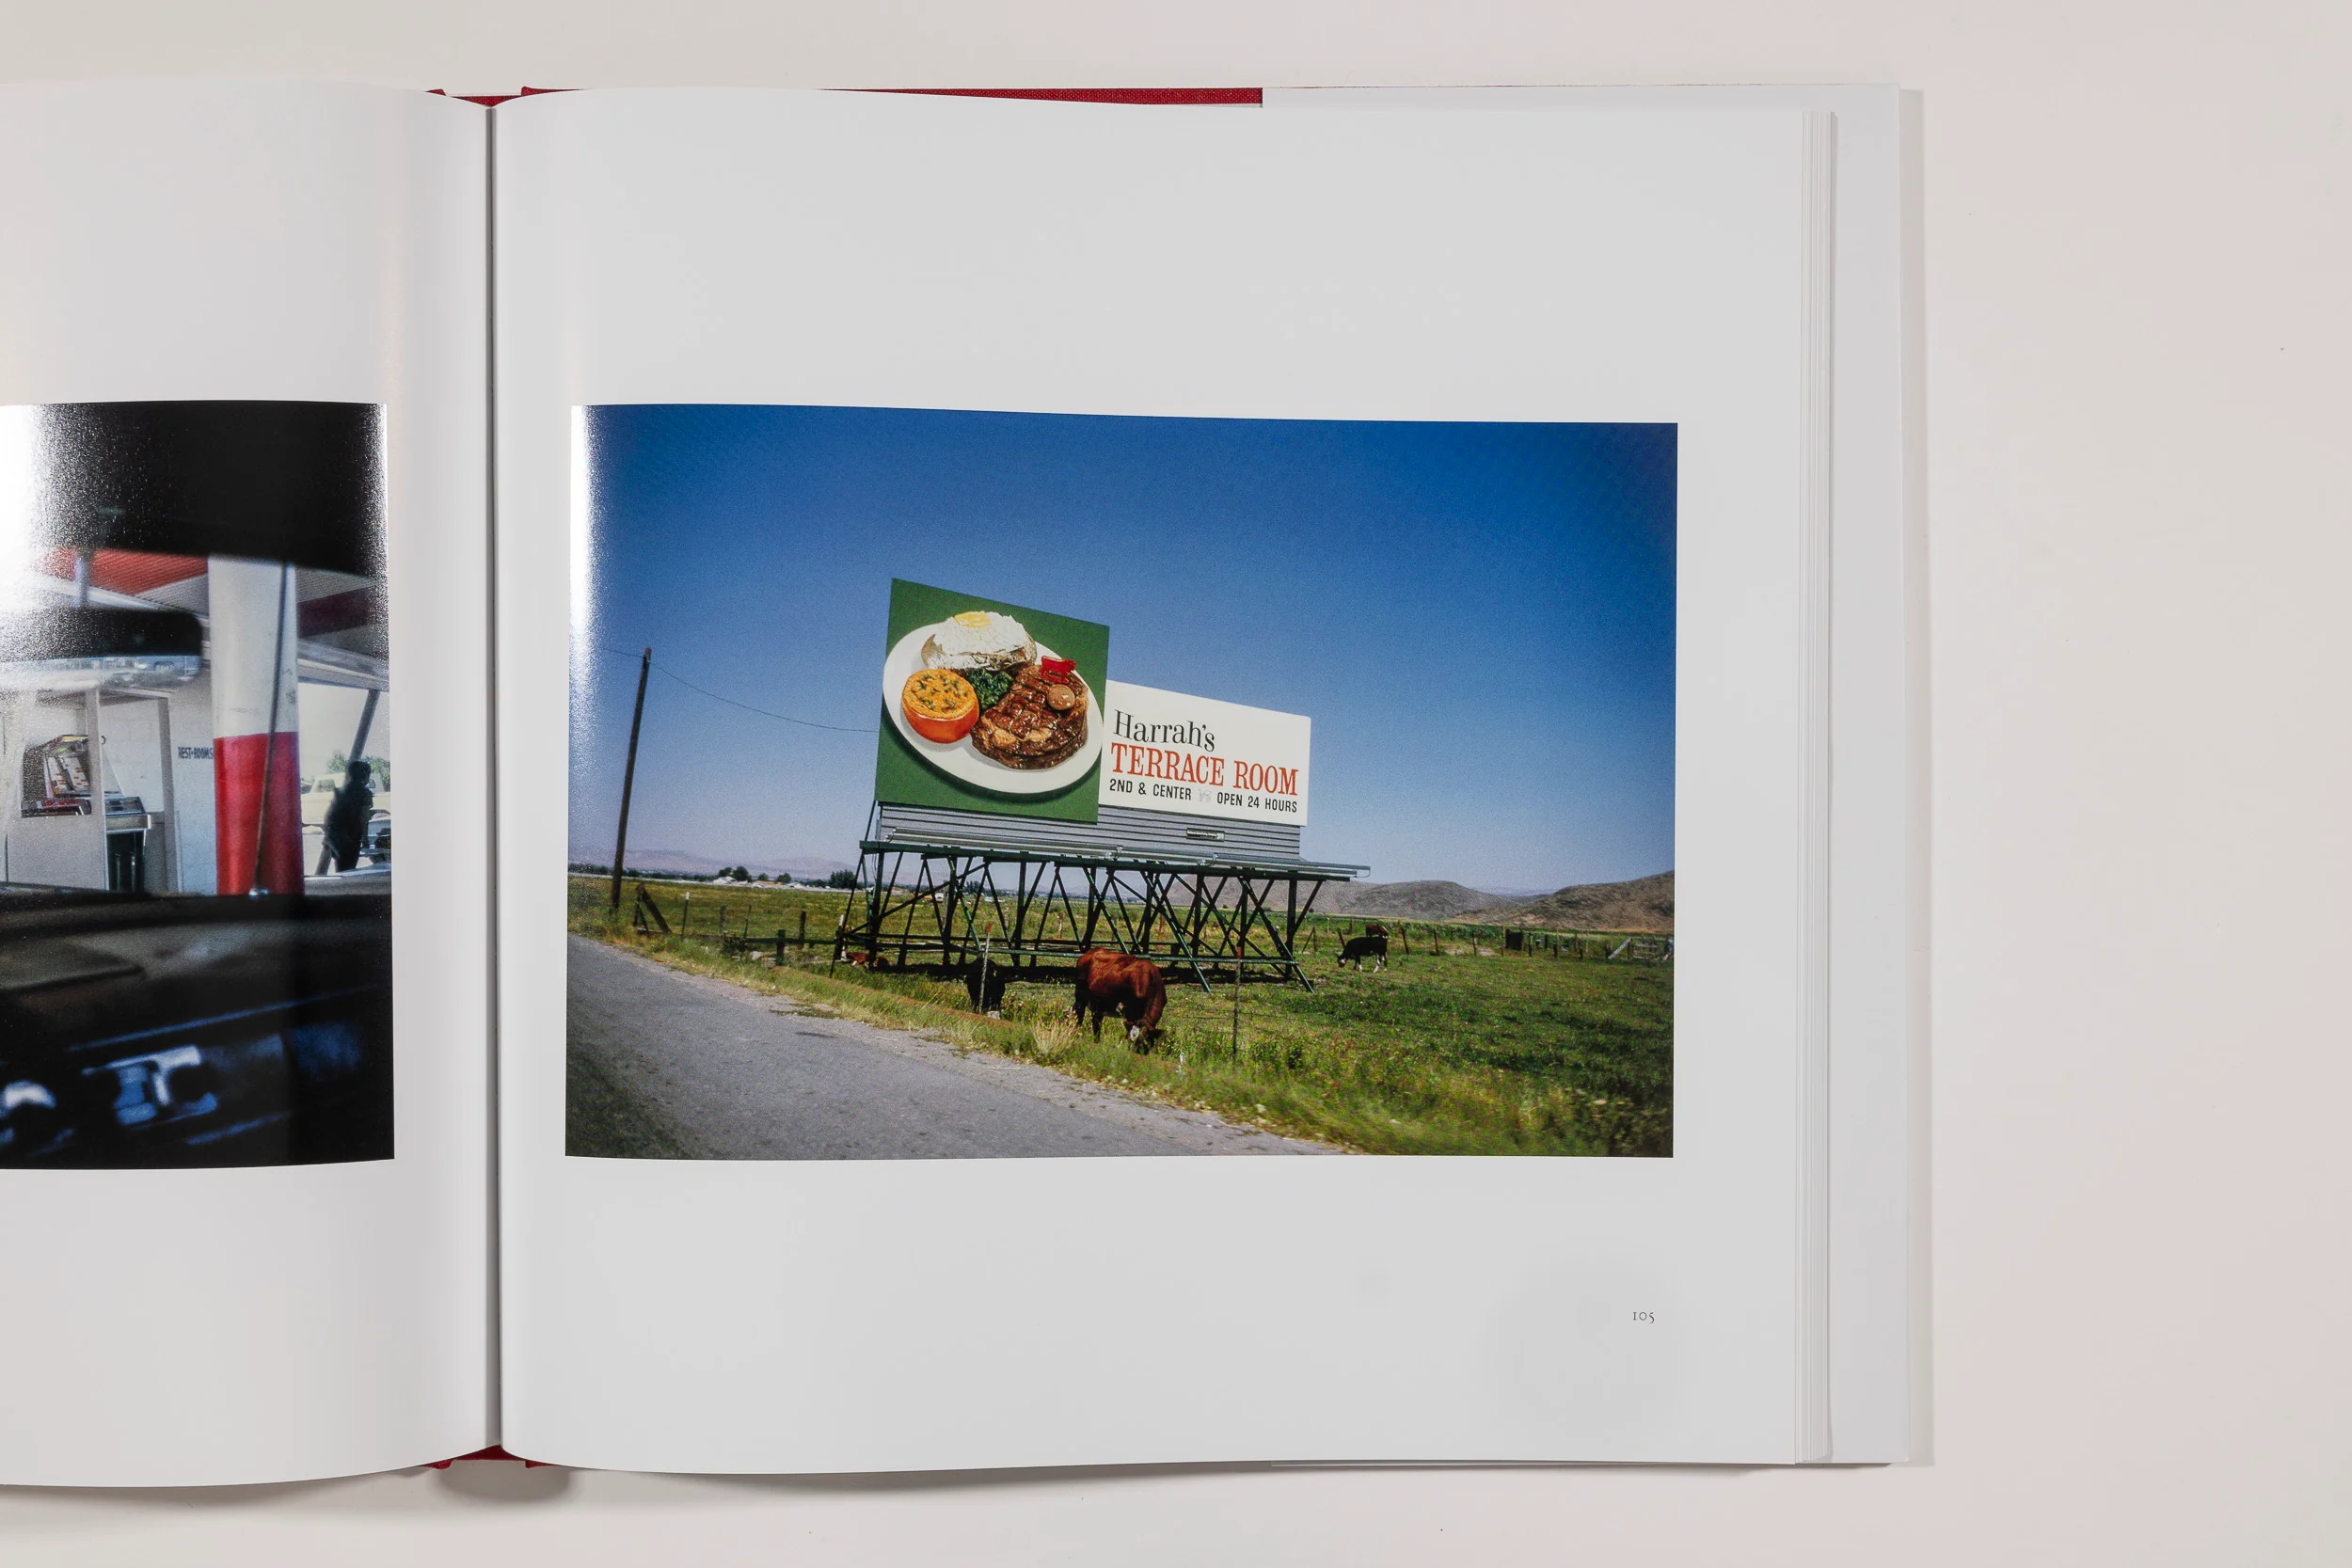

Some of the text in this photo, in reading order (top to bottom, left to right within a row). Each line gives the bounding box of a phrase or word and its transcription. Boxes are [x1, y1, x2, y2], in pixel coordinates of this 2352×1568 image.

[1113, 709, 1216, 752] Harrah's
[1111, 742, 1299, 796] TERRACE ROOM
[1109, 779, 1192, 800] 2ND & CENTER
[1216, 792, 1297, 813] OPEN 24 HOURS
